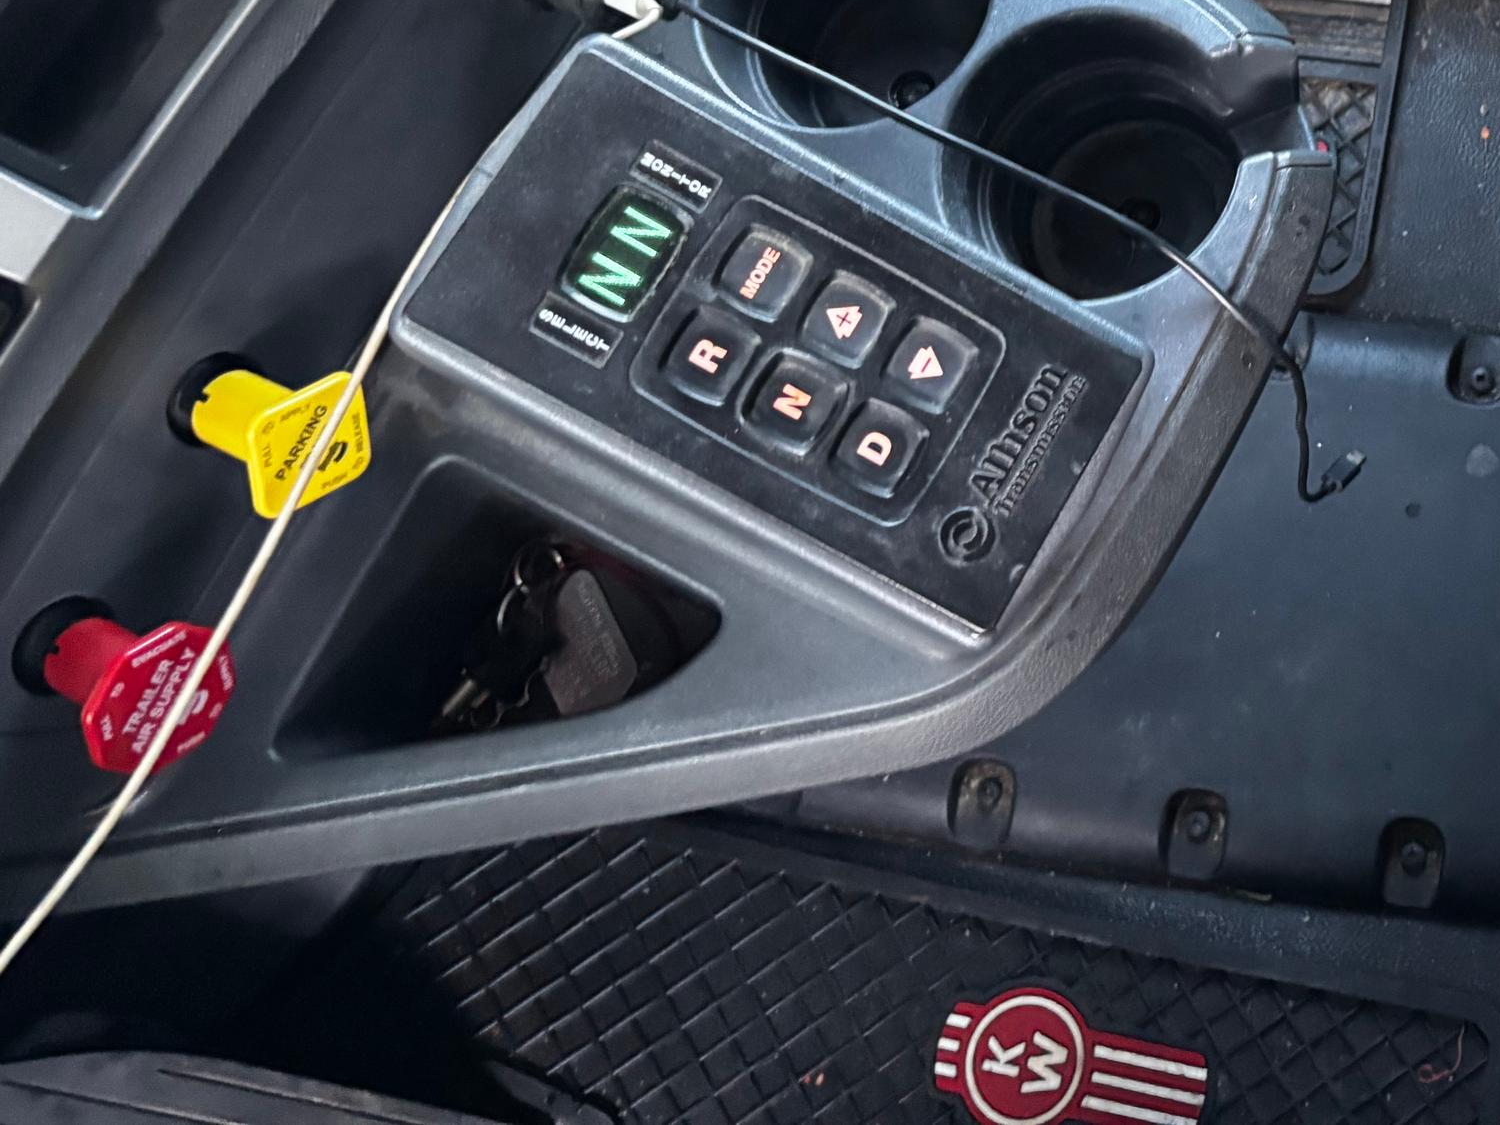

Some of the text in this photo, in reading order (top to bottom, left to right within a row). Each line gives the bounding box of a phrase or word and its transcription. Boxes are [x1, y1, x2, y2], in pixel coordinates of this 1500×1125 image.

[640, 152, 712, 199] MONITOR
[739, 246, 781, 300] MODE
[539, 308, 610, 351] SELECT
[688, 339, 728, 374] R
[772, 383, 812, 420] N
[274, 405, 328, 481] PARKING
[856, 431, 892, 467] D
[969, 364, 1068, 508] Allison
[122, 659, 175, 735] TRAILER
[131, 722, 156, 753] AIR
[149, 647, 195, 718] SUPPLY
[982, 1035, 1026, 1078] K
[1020, 1031, 1068, 1093] W
